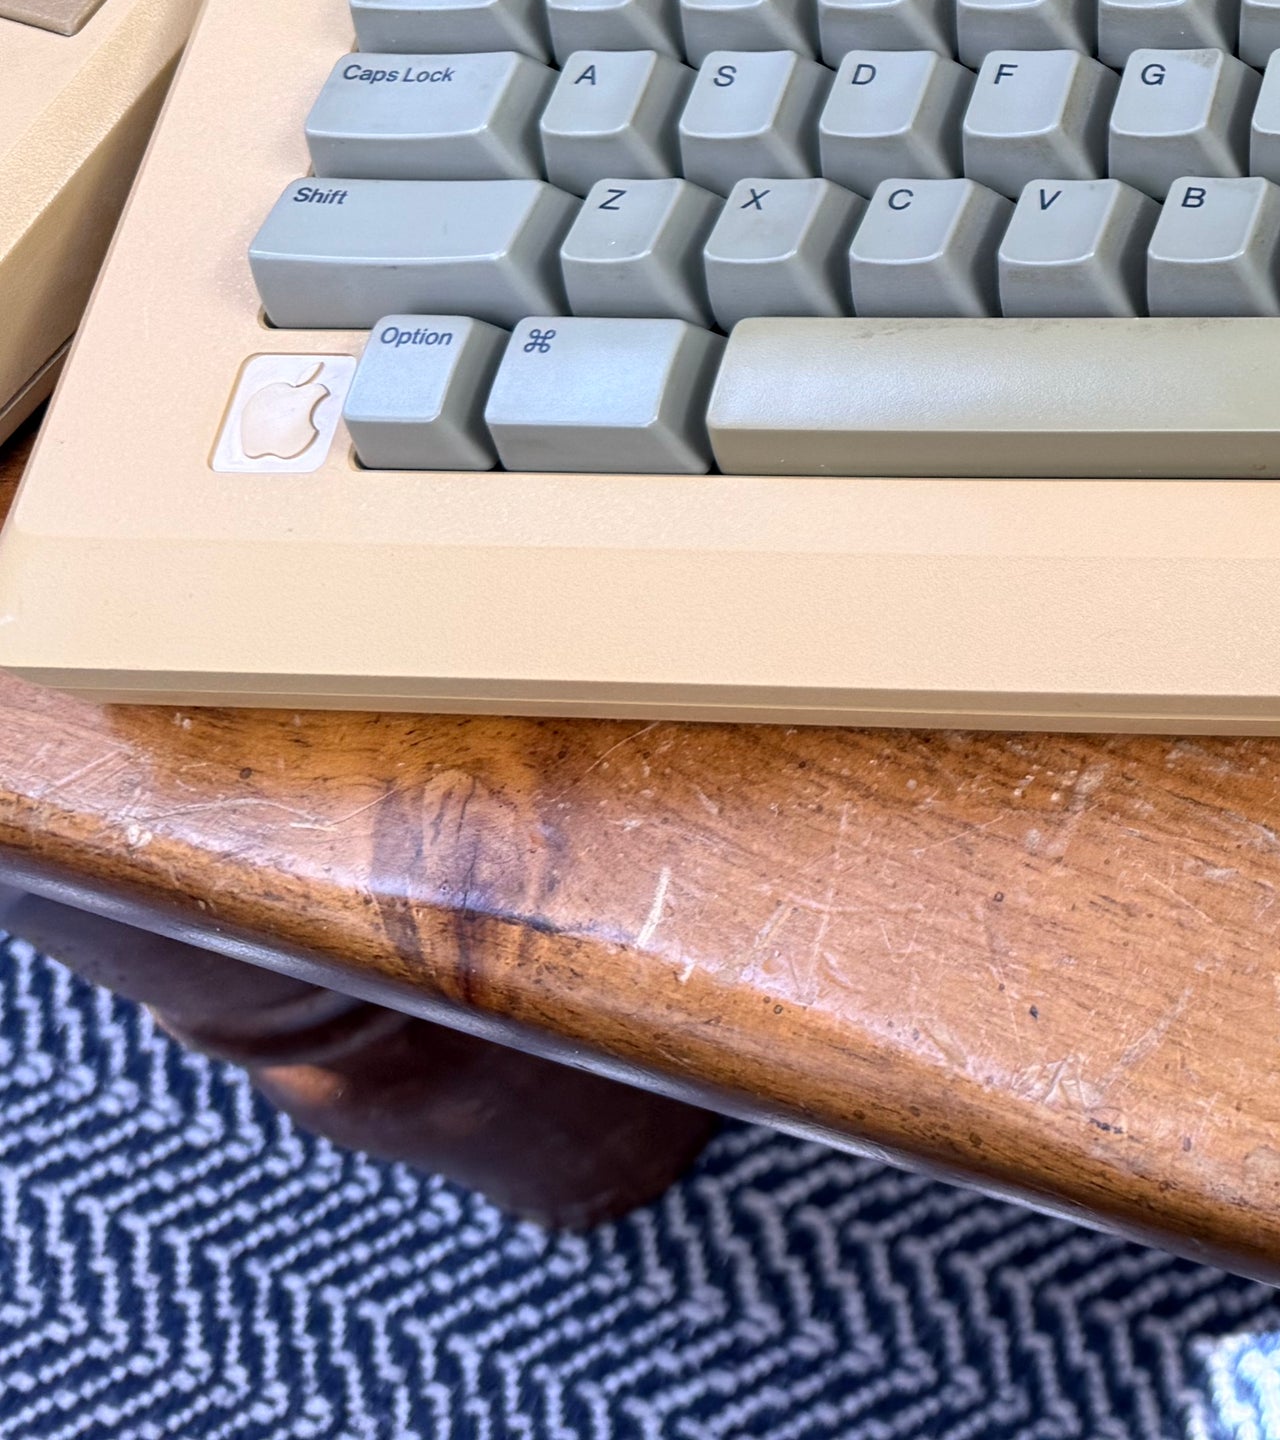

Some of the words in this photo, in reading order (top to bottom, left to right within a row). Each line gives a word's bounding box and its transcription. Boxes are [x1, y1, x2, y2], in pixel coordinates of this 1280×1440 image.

[342, 63, 399, 84] Caps
[400, 66, 456, 84] Lock
[572, 64, 597, 86] A
[712, 64, 738, 88] S
[850, 63, 877, 86] D
[992, 63, 1019, 85] F
[1140, 63, 1167, 86] G
[292, 186, 349, 205] Shift
[597, 188, 628, 211] Z
[739, 188, 771, 211] X
[887, 188, 915, 211] C
[1039, 188, 1063, 211] V
[1180, 186, 1207, 209] B
[380, 325, 453, 348] Option
